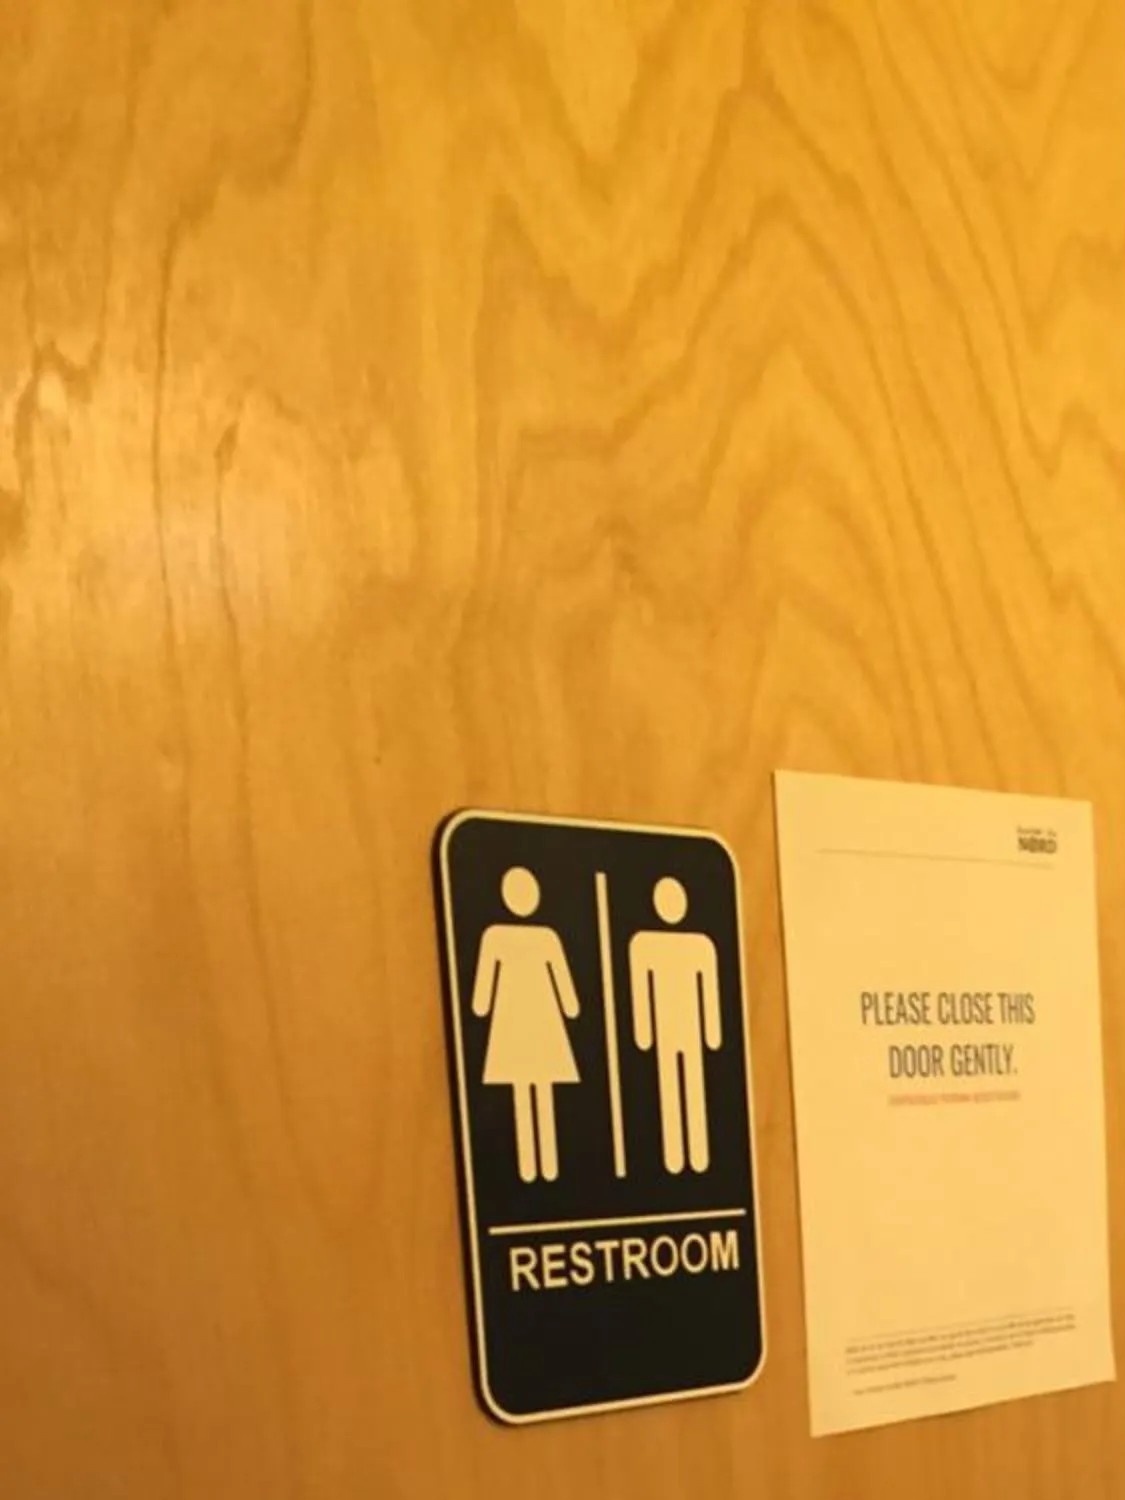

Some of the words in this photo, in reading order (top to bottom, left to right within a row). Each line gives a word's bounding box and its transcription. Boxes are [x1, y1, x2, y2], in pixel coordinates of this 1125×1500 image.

[861, 991, 932, 1026] PLEASE
[937, 991, 994, 1025] CLOSE
[996, 991, 1036, 1025] THIS
[889, 1044, 945, 1079] DOOR
[951, 1043, 1018, 1077] GENTLY.
[510, 1230, 739, 1291] RESTROOM
